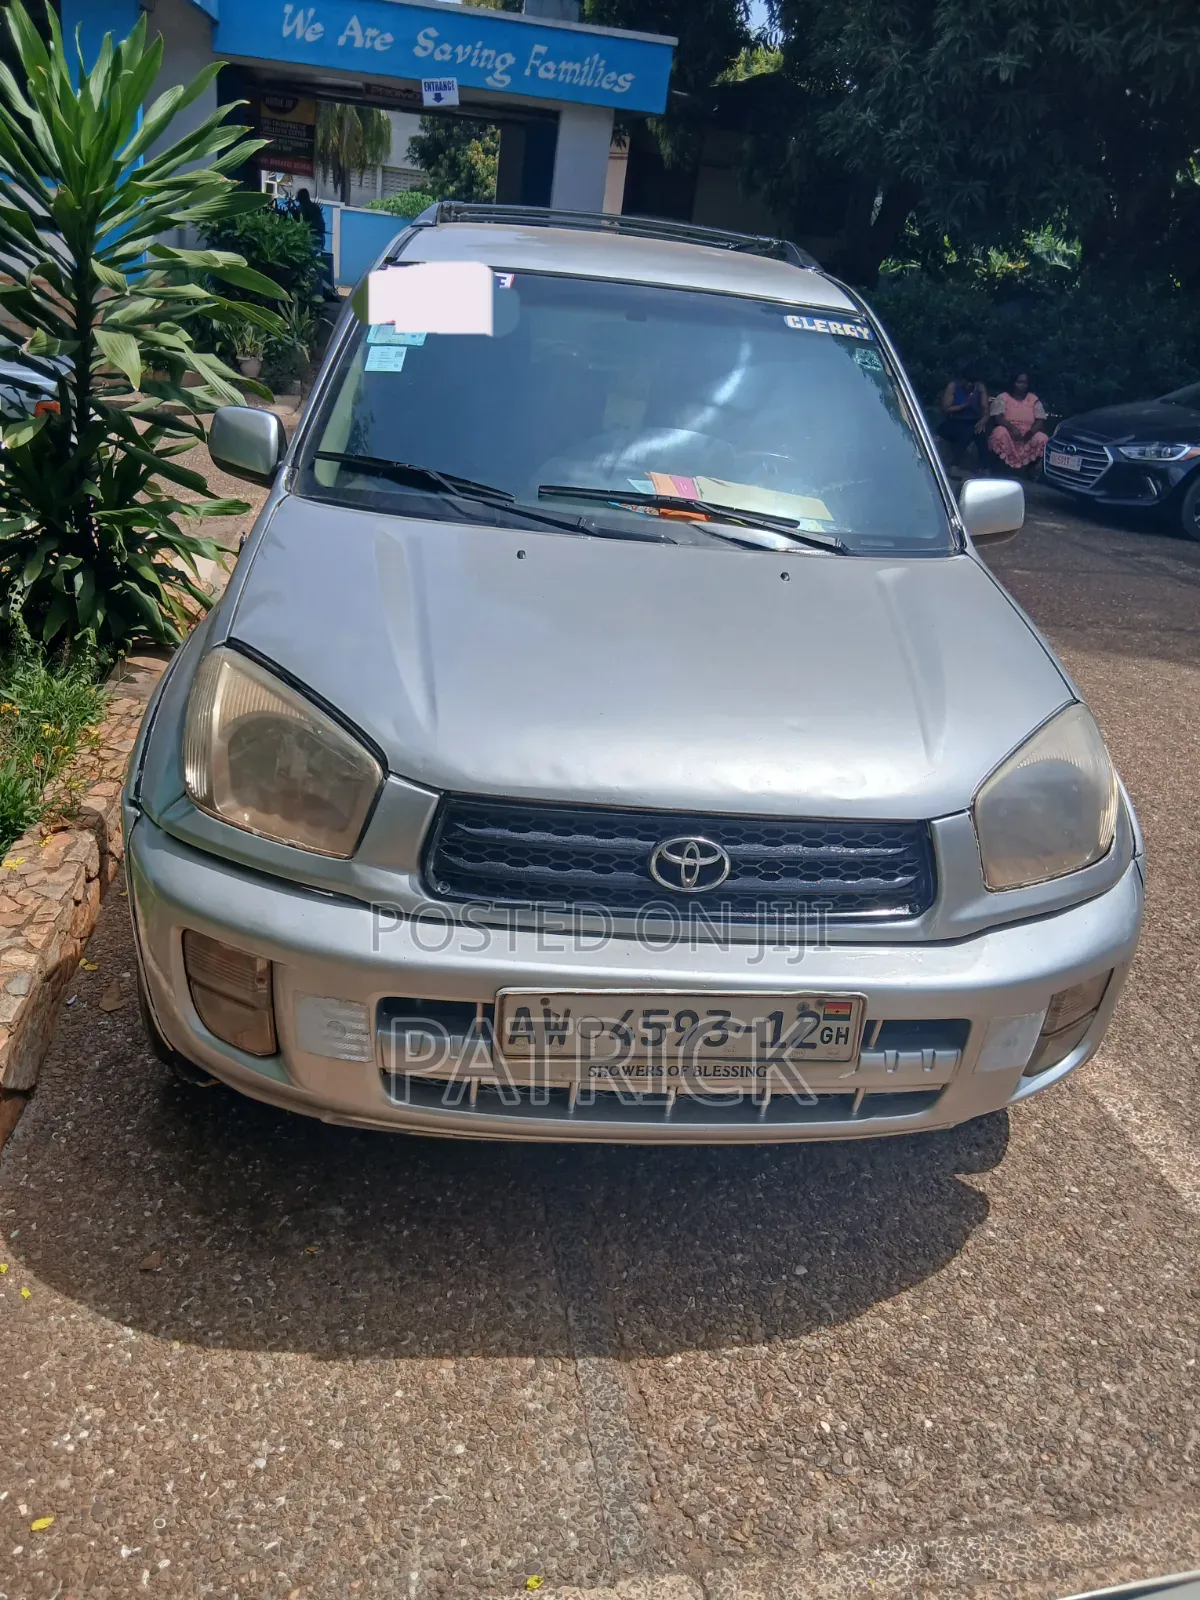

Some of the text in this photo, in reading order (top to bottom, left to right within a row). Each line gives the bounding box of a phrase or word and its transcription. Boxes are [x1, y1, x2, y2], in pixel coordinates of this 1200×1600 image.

[281, 4, 636, 93] We Are Saving Families
[423, 81, 456, 93] ENTRANCE
[785, 315, 870, 340] CLERGY
[508, 1006, 571, 1046] AW
[819, 1025, 850, 1046] GH
[587, 1065, 767, 1078] SHOWERS OF BLESSING
